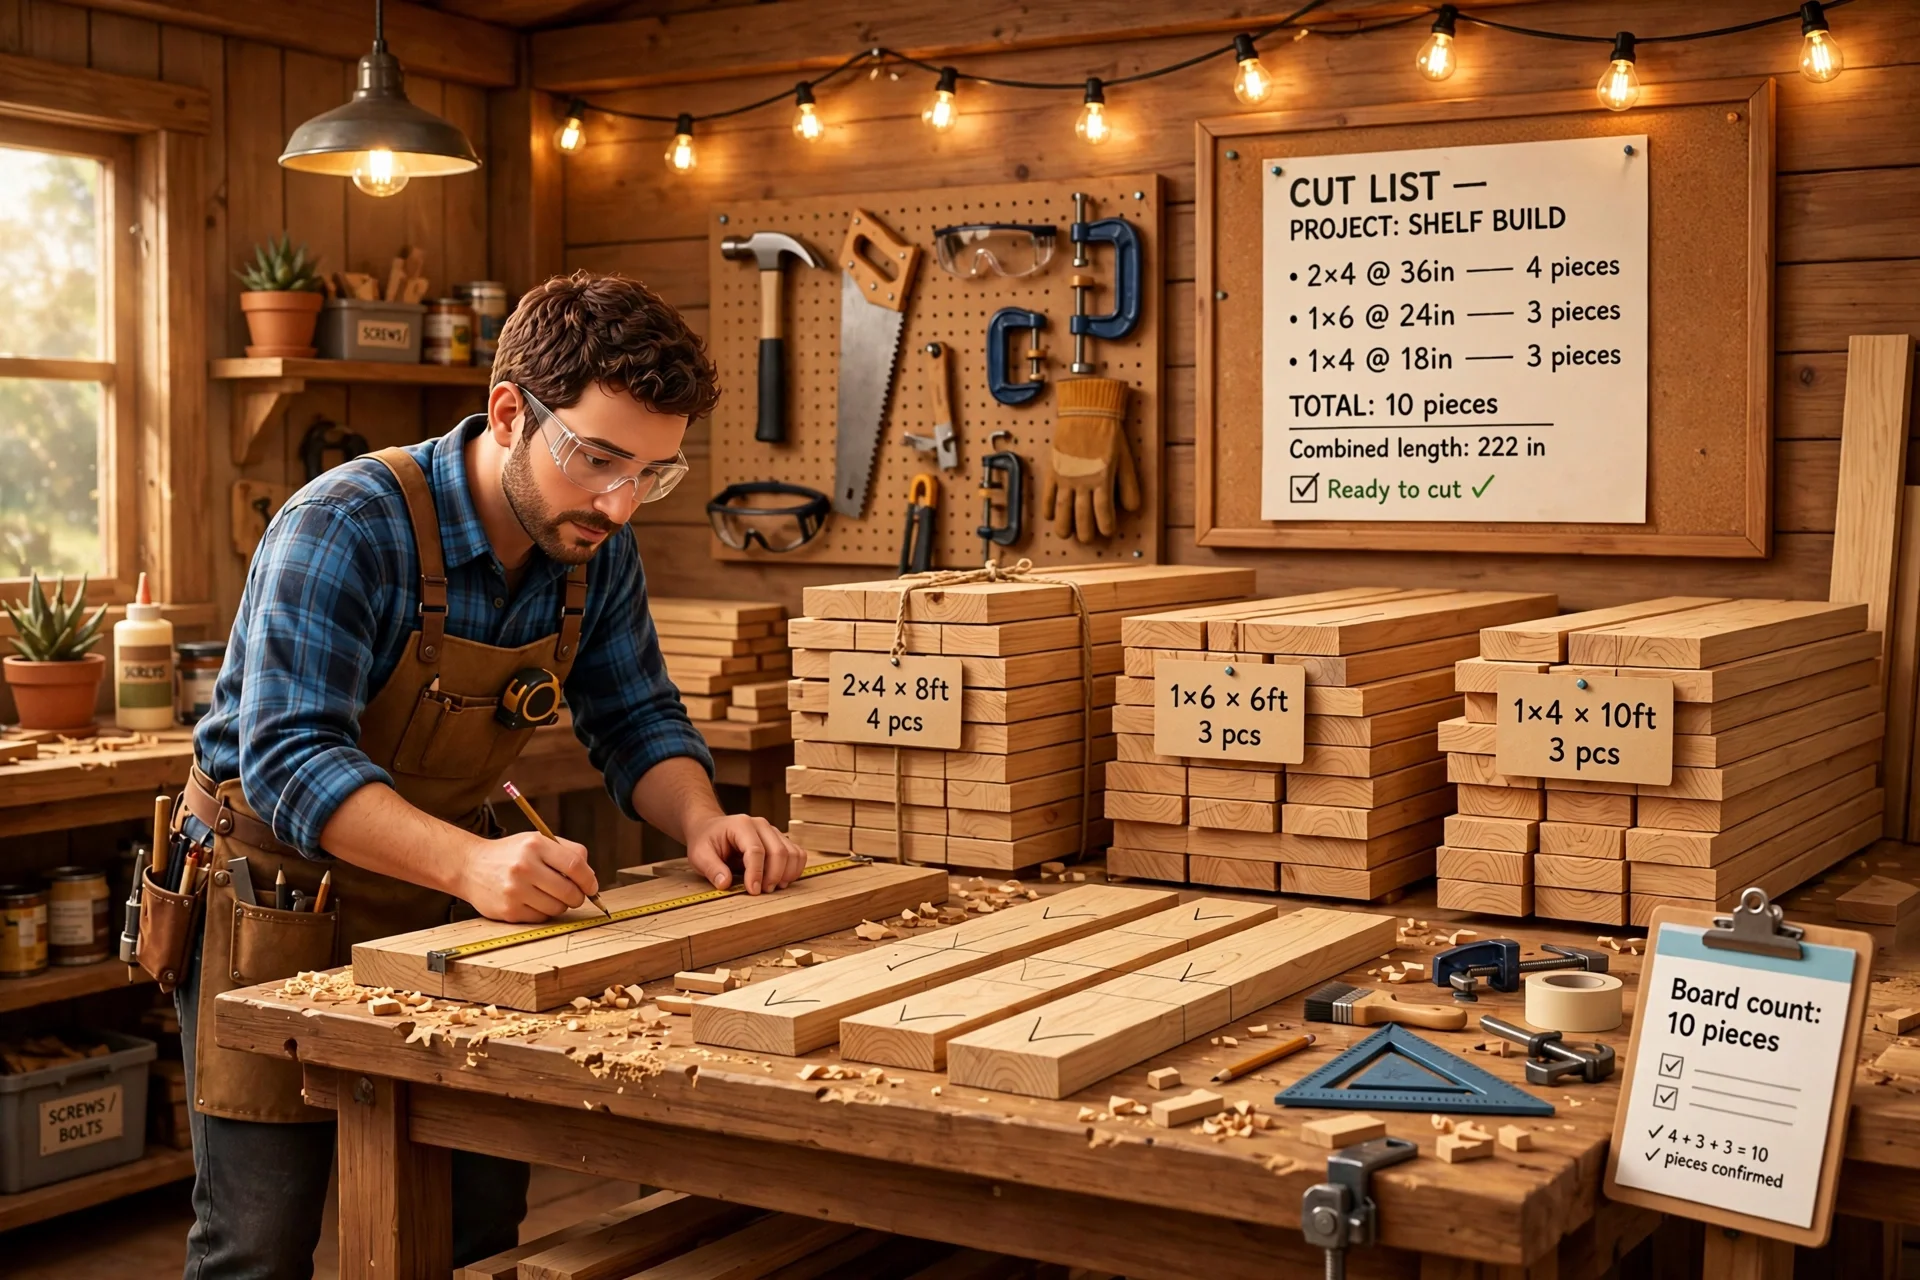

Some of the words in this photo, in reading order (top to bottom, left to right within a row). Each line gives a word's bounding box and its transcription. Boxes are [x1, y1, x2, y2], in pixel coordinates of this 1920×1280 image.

[1289, 175, 1357, 208] CUT
[1370, 170, 1441, 204] LIST
[1290, 214, 1399, 242] PROJECT:
[1408, 210, 1484, 236] SHELF
[1492, 205, 1566, 232] BUILD
[1366, 260, 1391, 287] @
[1400, 259, 1455, 284] 36in
[1526, 255, 1543, 279] 4
[1551, 255, 1620, 285] pieces
[1365, 303, 1389, 330] @
[1399, 302, 1455, 328] 24in
[1527, 299, 1542, 324] 3
[1551, 300, 1621, 329] pieces
[1366, 346, 1390, 374] @
[1401, 346, 1453, 371] 18in
[1526, 343, 1542, 368] 3
[1551, 344, 1622, 373] pieces
[1288, 393, 1374, 418] TOTAL:
[1385, 392, 1414, 417] 10
[1424, 392, 1498, 423] pieces
[1289, 437, 1389, 459] Combined
[1397, 435, 1469, 464] length:
[1477, 435, 1519, 457] 222
[1527, 436, 1546, 457] in
[1328, 477, 1391, 505] Ready
[1397, 480, 1420, 499] to
[1427, 480, 1462, 499] cut
[915, 676, 950, 702] 8ft
[1250, 686, 1289, 713] 6ft
[866, 707, 881, 730] 4
[888, 715, 923, 737] pcs
[1601, 701, 1657, 730] 10ft
[1198, 720, 1213, 744] 3
[1222, 728, 1261, 752] pcs
[1548, 736, 1565, 763] 3
[1576, 745, 1620, 771] pcs
[1670, 977, 1741, 1010] Board
[1746, 996, 1822, 1024] count:
[1668, 1011, 1696, 1037] 10
[1701, 1019, 1780, 1053] pieces
[48, 1097, 106, 1126] SCREWS
[59, 1119, 104, 1143] BOLTS
[1667, 1128, 1678, 1144] 4
[1682, 1134, 1691, 1144] +
[1695, 1133, 1705, 1149] 3
[1710, 1140, 1719, 1150] +
[1722, 1139, 1733, 1155] 3
[1737, 1146, 1747, 1155] =
[1751, 1145, 1769, 1163] 10
[1664, 1151, 1708, 1172] pieces
[1711, 1163, 1784, 1189] confirmed
